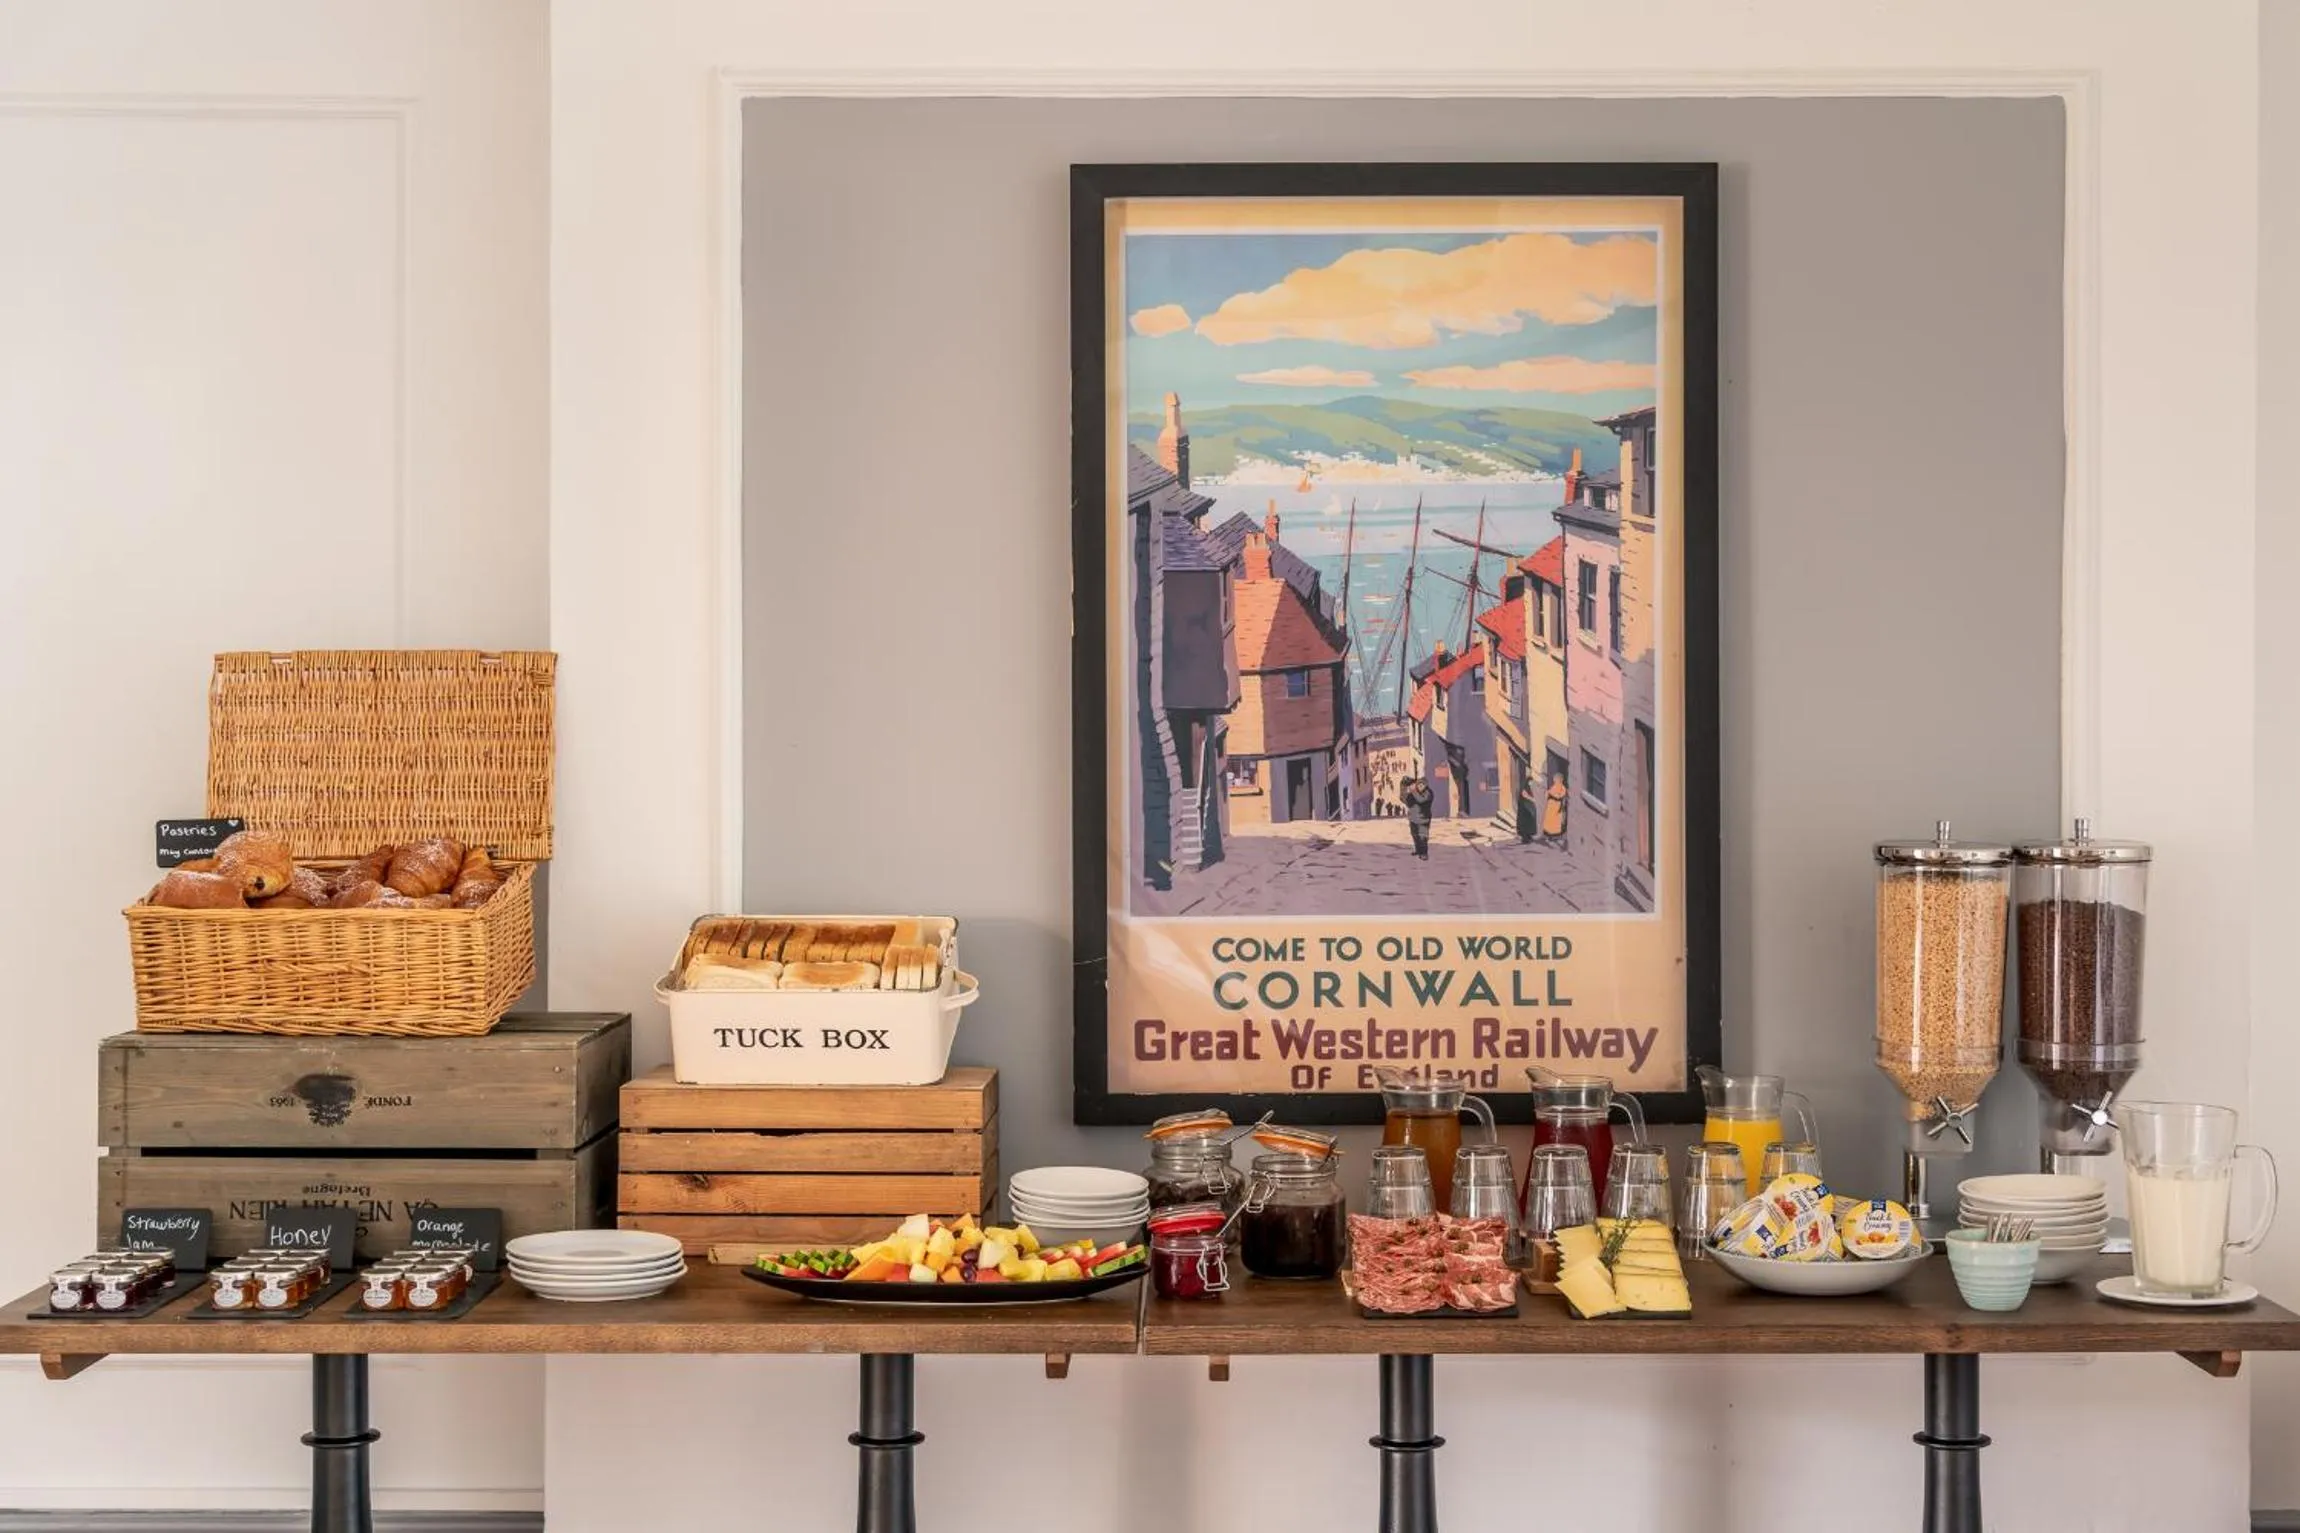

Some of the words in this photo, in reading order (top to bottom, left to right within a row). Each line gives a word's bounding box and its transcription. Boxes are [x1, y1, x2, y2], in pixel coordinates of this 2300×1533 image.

[160, 823, 217, 837] Pastries
[1212, 937, 1305, 962] COME
[1319, 937, 1363, 961] TO
[1376, 936, 1443, 961] OLD
[1457, 936, 1573, 961] WORLD
[1213, 970, 1573, 1010] CORNWALL
[713, 1027, 804, 1049] TUCK
[820, 1028, 891, 1050] BOX
[1133, 1018, 1261, 1062] Great
[1269, 1018, 1457, 1061] Western
[1472, 1017, 1659, 1073] Railway
[1291, 1064, 1332, 1089] Of
[1357, 1063, 1499, 1089] Eland
[127, 1214, 201, 1241] Strawberry
[270, 1224, 333, 1246] Honey
[417, 1219, 465, 1240] Orange
